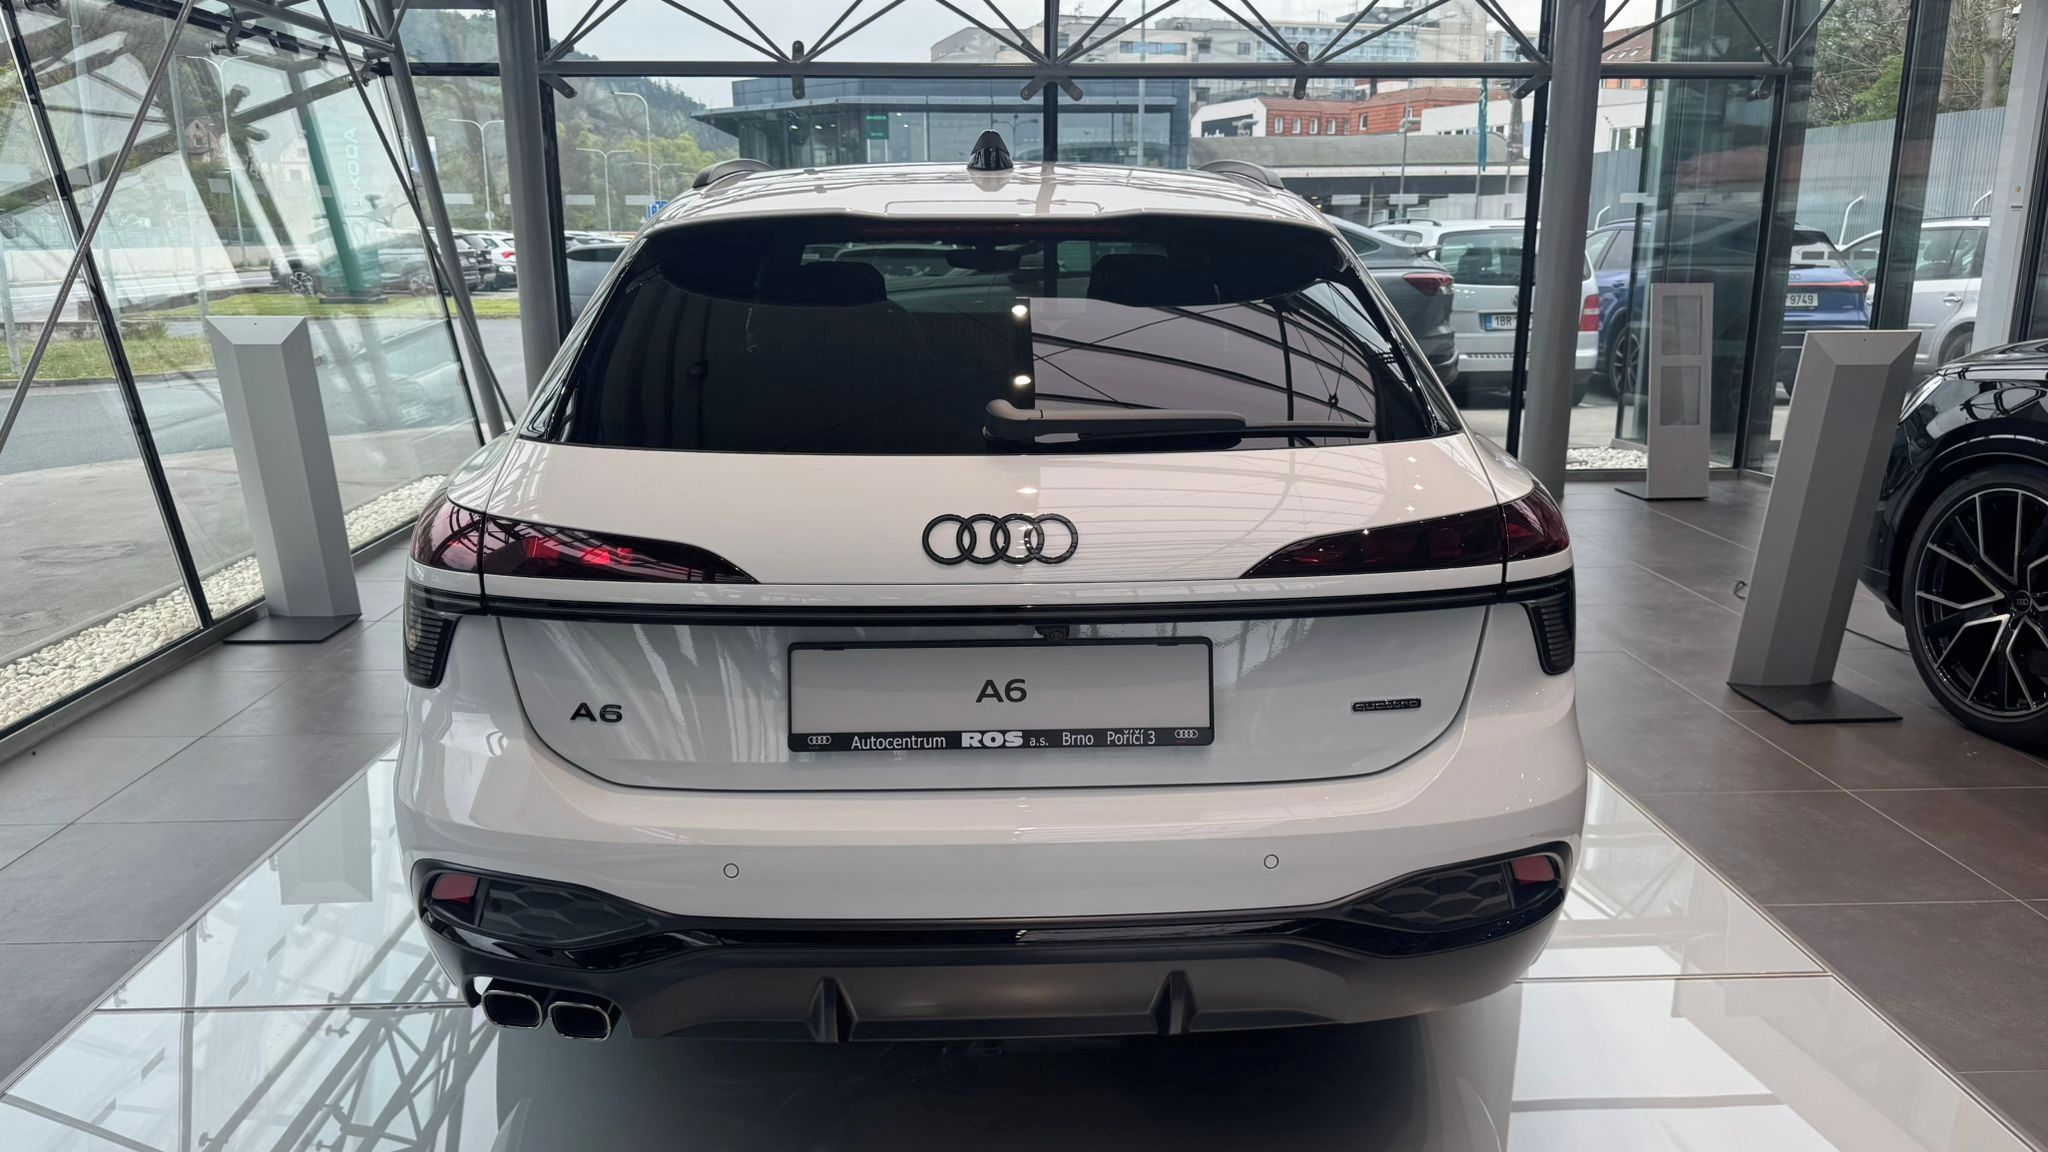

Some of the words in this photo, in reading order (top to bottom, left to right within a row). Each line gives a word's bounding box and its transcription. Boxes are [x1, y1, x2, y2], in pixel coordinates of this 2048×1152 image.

[1790, 294, 1813, 305] 9749
[975, 678, 1027, 703] A6
[570, 702, 623, 723] A6
[1354, 699, 1420, 711] quattro
[851, 735, 946, 749] Autocentrum
[961, 731, 1023, 748] ROS
[1029, 736, 1049, 747] a.s.
[1062, 731, 1094, 746] Brno
[1107, 729, 1144, 745] Poříčí
[1148, 730, 1155, 745] 3
